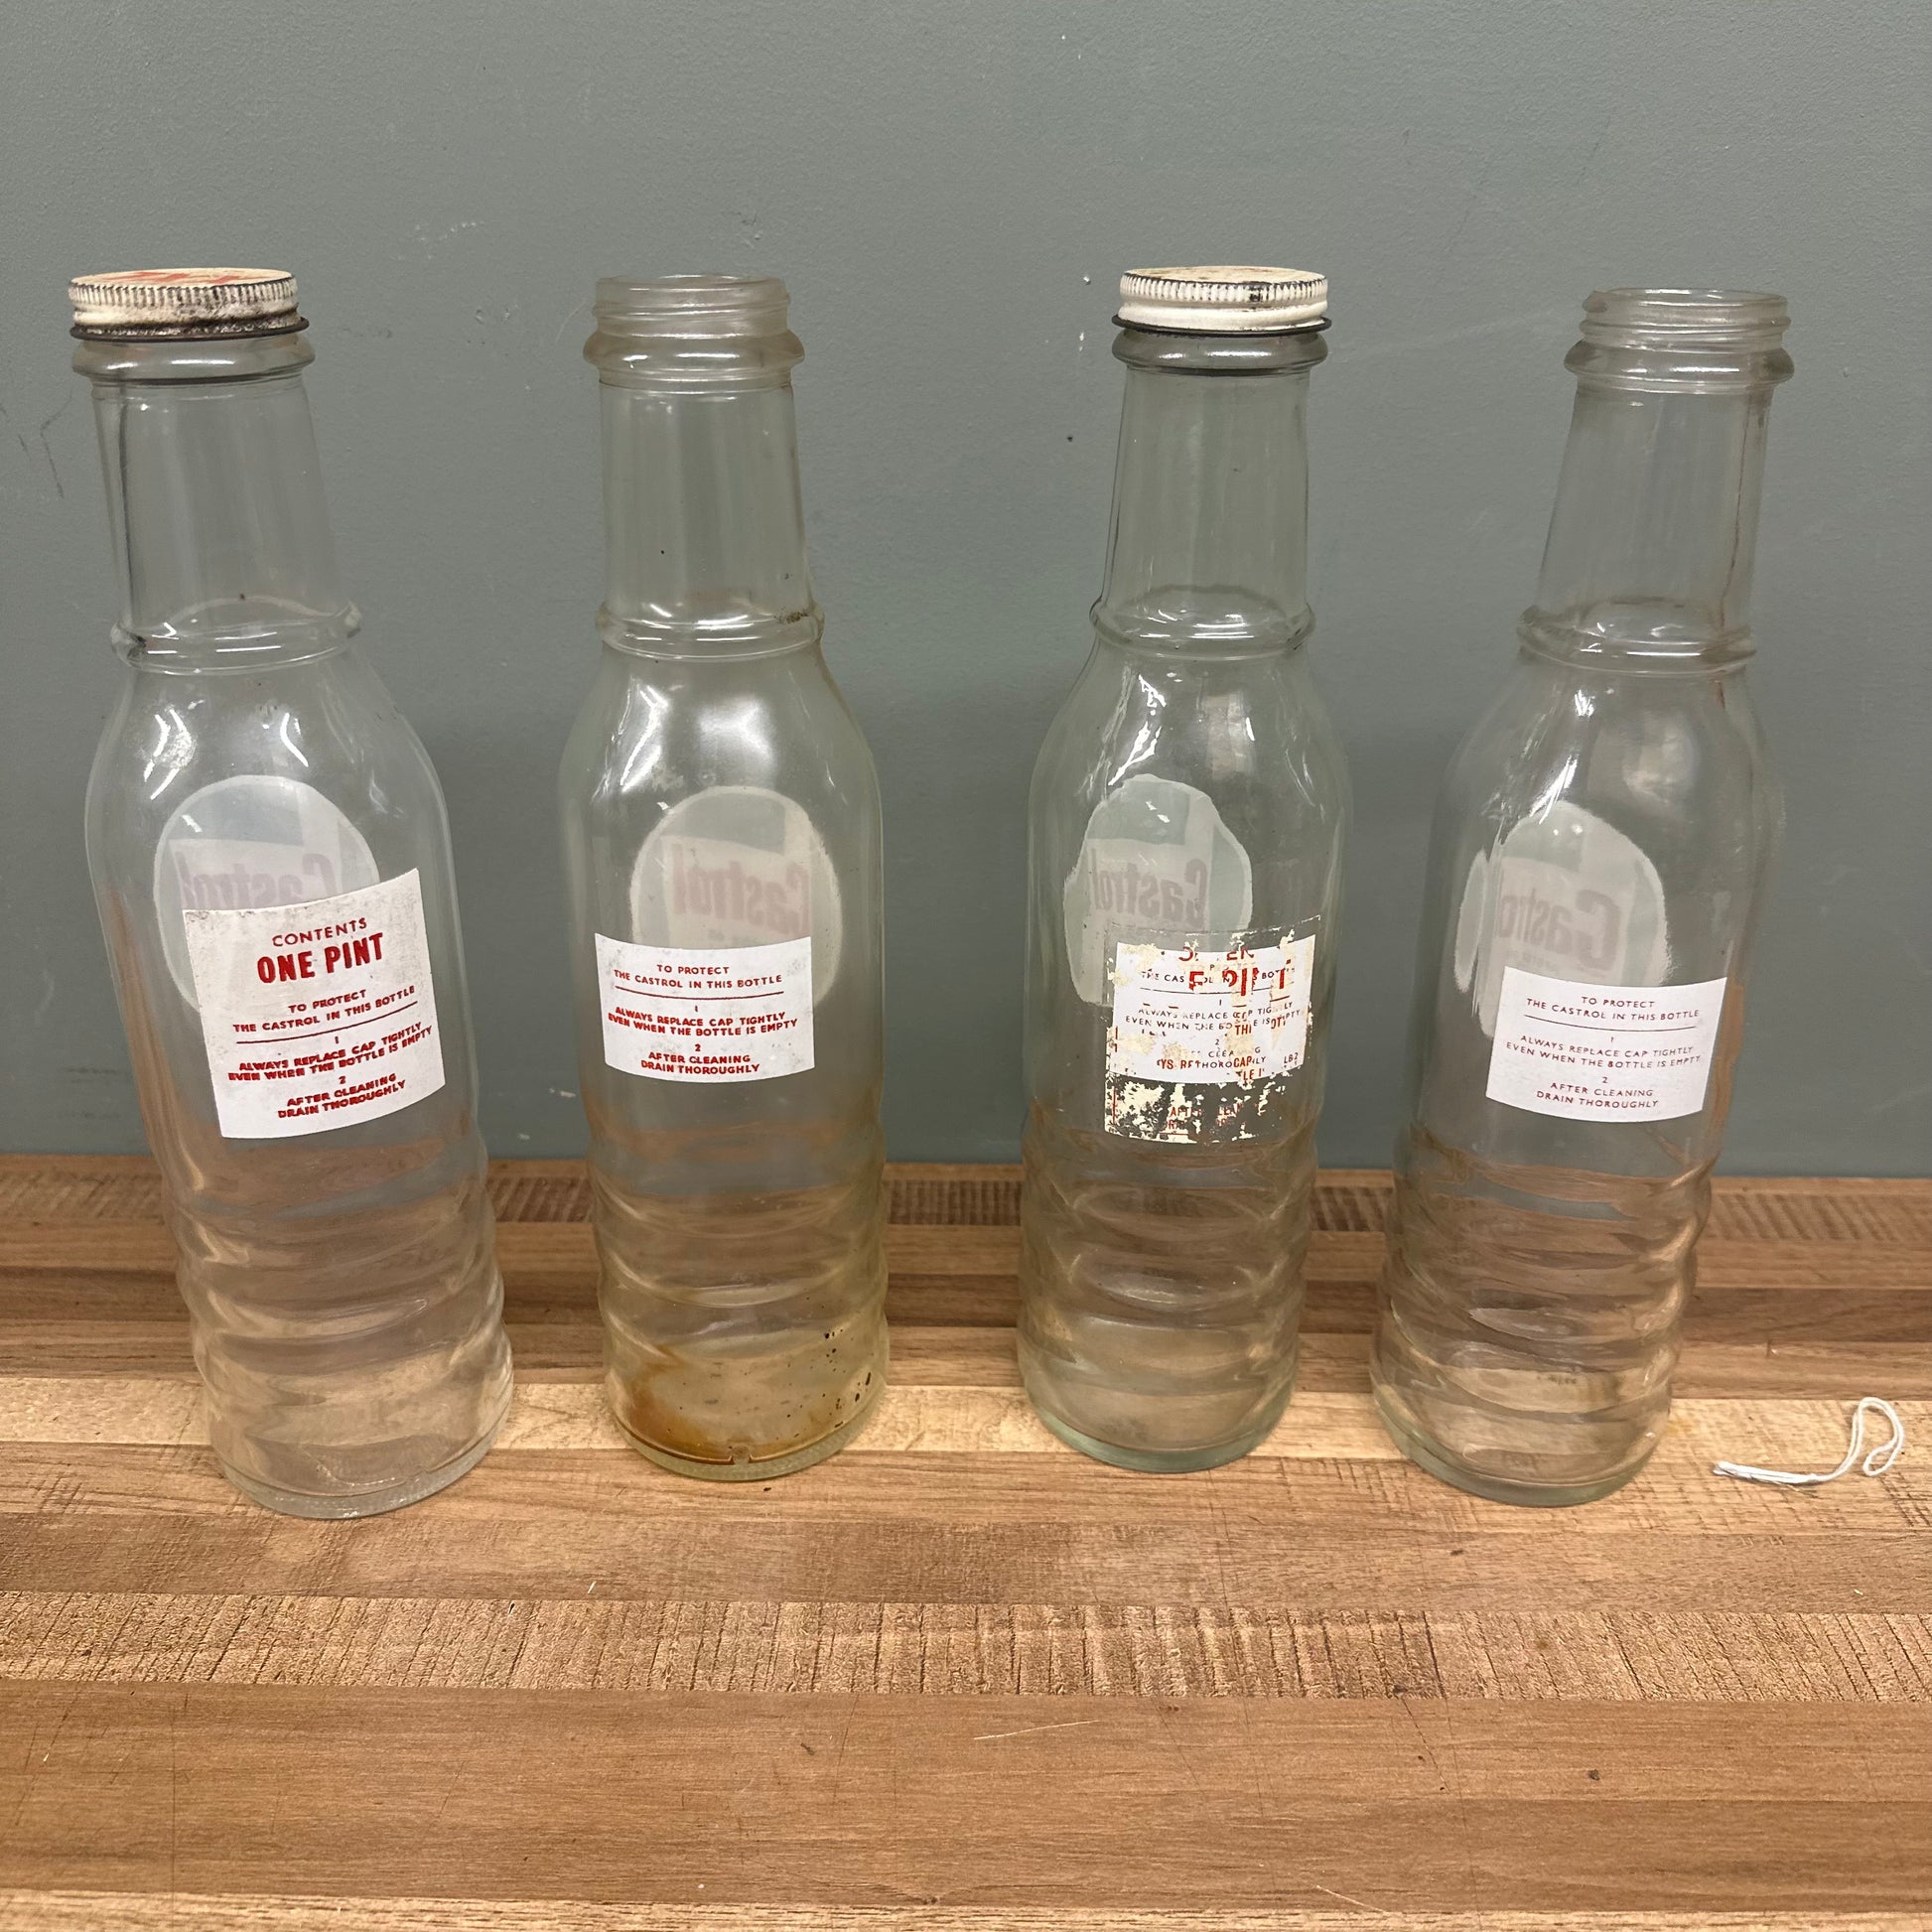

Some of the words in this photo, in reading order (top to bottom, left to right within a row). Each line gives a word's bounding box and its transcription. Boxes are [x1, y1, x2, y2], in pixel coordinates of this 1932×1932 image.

[272, 917, 367, 947] CONTENTS
[257, 951, 316, 984] ONE
[325, 932, 383, 974] PINT
[614, 969, 631, 981] THE
[634, 975, 683, 988] CASTROL
[688, 980, 702, 989] IN
[707, 980, 733, 989] THIS
[738, 975, 782, 988] BOTTLE
[656, 964, 672, 973] TO
[678, 966, 730, 975] PROTECT
[1164, 974, 1214, 984] CASOL
[232, 1024, 257, 1033] THE
[262, 1016, 321, 1032] CASTROL
[326, 1010, 341, 1021] IN
[345, 1003, 371, 1018] THIS
[375, 986, 415, 1008] BOTTLE
[289, 1001, 307, 1013] TO
[313, 989, 366, 1010] PROTECT
[1258, 1001, 1293, 1015] TIGLY
[1526, 998, 1547, 1010] THE
[1551, 1004, 1606, 1020] CASTROL
[1612, 1012, 1626, 1021] IN
[1660, 1010, 1700, 1021] BOTTLE
[1582, 996, 1597, 1006] TO
[1603, 999, 1656, 1009] PROTECT
[608, 1013, 630, 1027] EVEN
[632, 1021, 665, 1034] WHEN
[670, 1027, 692, 1035] THE
[696, 1027, 742, 1036] BOTTLE
[746, 1026, 757, 1035] IS
[760, 1018, 798, 1034] EMPTY
[615, 1007, 653, 1022] ALWAYS
[656, 1016, 704, 1027] REPLACE
[739, 1012, 786, 1026] TIGHTLY
[1125, 1015, 1152, 1027] EVEN
[1157, 1021, 1189, 1030] WHEN
[227, 1071, 261, 1081] EVEN
[264, 1066, 306, 1080] WHEN
[311, 1060, 335, 1074] THE
[339, 1047, 385, 1068] BOTTLE
[388, 1042, 399, 1054] IS
[401, 1026, 433, 1048] EMPTY
[238, 1059, 289, 1071] ALWAYS
[294, 1049, 345, 1067] REPLACE
[351, 1040, 376, 1055] CAP
[381, 1022, 422, 1045] TIGHTLY
[1506, 1041, 1535, 1055] EVEN
[1540, 1050, 1576, 1064] WHEN
[1582, 1057, 1603, 1067] THE
[1670, 1055, 1701, 1066] EMPTY
[1520, 1035, 1564, 1051] ALWAYS
[1569, 1045, 1619, 1057] REPLACE
[1653, 1046, 1694, 1057] TIGHTLY
[640, 1059, 674, 1073] DRAIN
[678, 1063, 760, 1075] THOROUGHLY
[648, 1051, 686, 1063] AFTER
[689, 1054, 751, 1064] CLEANING
[287, 1092, 331, 1107] AFTER
[334, 1073, 397, 1098] CLEANING
[339, 1075, 346, 1084] 2
[1550, 1082, 1588, 1094] AFTER
[1593, 1088, 1654, 1097] CLEANING
[277, 1104, 320, 1119] DRAIN
[323, 1079, 406, 1111] THOROUGHLY
[1536, 1090, 1574, 1104] DRAIN
[1579, 1098, 1659, 1109] THOROUGHLY
